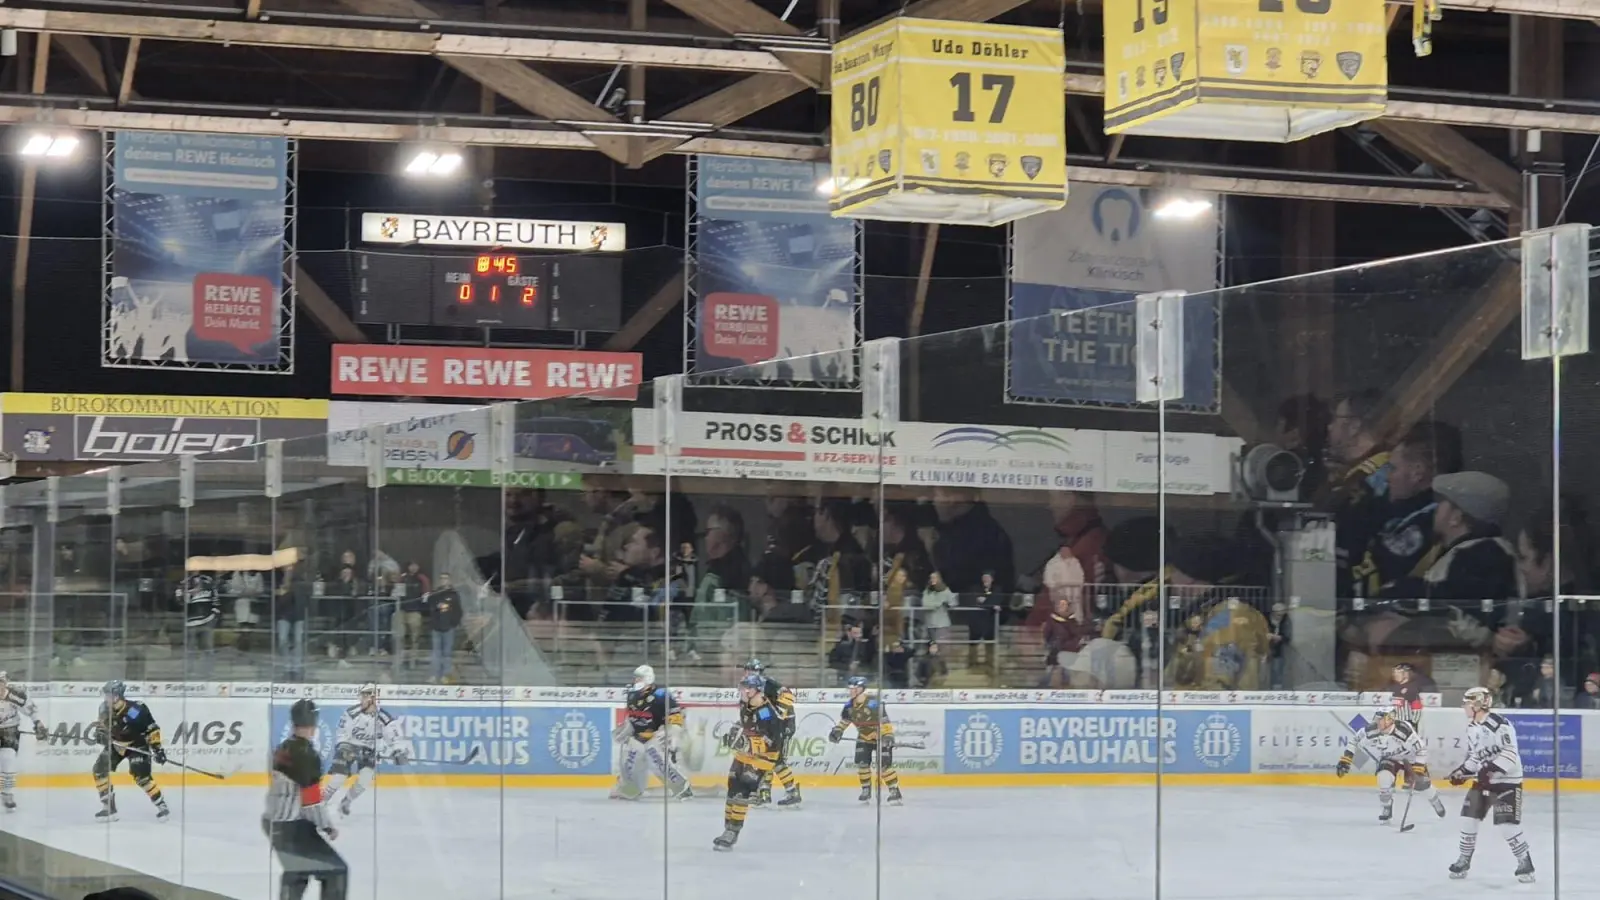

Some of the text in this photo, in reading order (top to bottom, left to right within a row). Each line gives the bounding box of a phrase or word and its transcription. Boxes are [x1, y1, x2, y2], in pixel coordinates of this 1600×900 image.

[932, 39, 1029, 59] Udo Döhler
[851, 76, 880, 132] 80
[949, 72, 1015, 123] 17
[175, 149, 217, 164] REWE
[752, 177, 791, 191] REWE
[413, 219, 576, 245] BAYREUTH
[204, 284, 261, 303] REWE
[460, 284, 470, 300] 0
[491, 285, 497, 300] 1
[523, 287, 534, 303] 2
[714, 304, 768, 321] REWE
[205, 316, 260, 330] Dein Markt
[715, 333, 736, 344] Dein
[1043, 338, 1097, 364] THE
[338, 356, 634, 389] REWE REWE REWE
[51, 396, 280, 416] BÜROKOMMUNIKATION
[705, 421, 896, 447] PROSS & SCHICK
[813, 452, 897, 466] KFZ-SERVCE
[408, 470, 473, 484] BLOCK 2
[491, 472, 539, 486] BLOCK
[910, 471, 976, 484] KLINIKUM
[981, 473, 1048, 486] BAYREUTH
[1054, 475, 1093, 488] GMBH
[172, 720, 243, 745] MGS
[1020, 717, 1177, 738] BAYREUTHER
[1259, 735, 1348, 747] FLIESEN
[1020, 740, 1177, 765] BRAUHAUS
[804, 757, 830, 772] Berg
